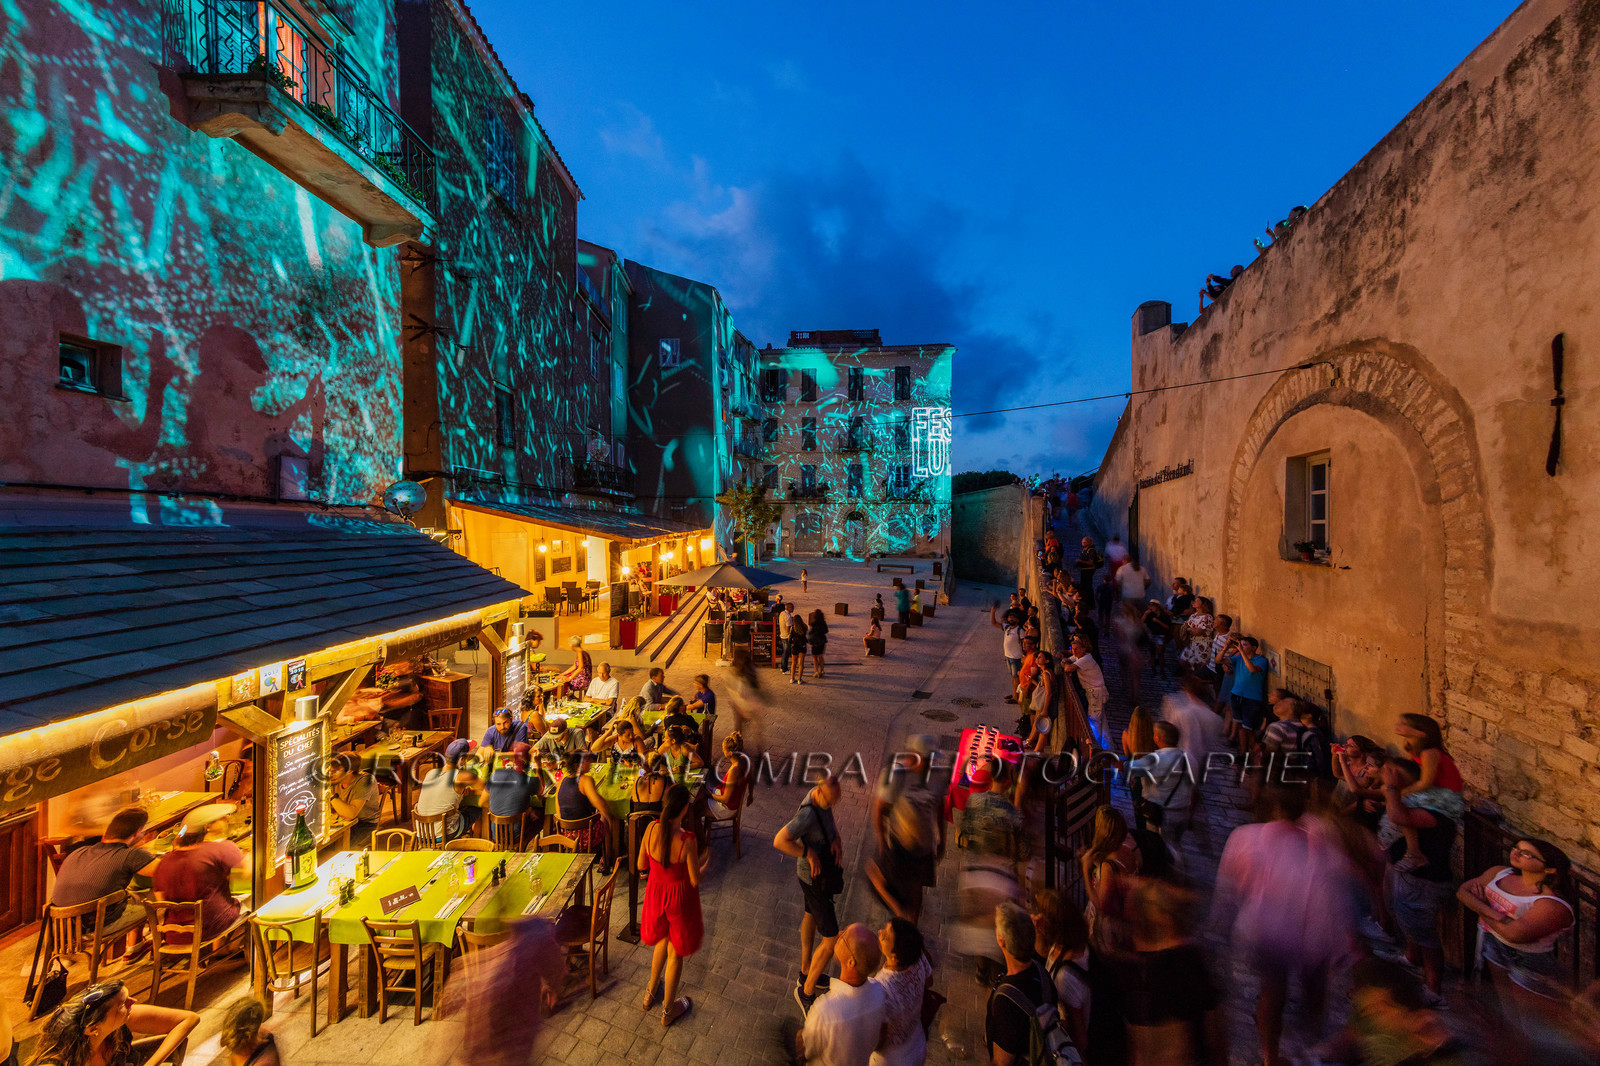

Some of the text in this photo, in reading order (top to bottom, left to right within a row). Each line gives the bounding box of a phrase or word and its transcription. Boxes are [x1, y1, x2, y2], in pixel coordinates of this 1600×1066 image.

[911, 438, 952, 478] LU
[280, 727, 320, 750] SPÉCIALITÉS
[283, 739, 315, 759] DU CHEF
[0, 711, 205, 802] ge Corse
